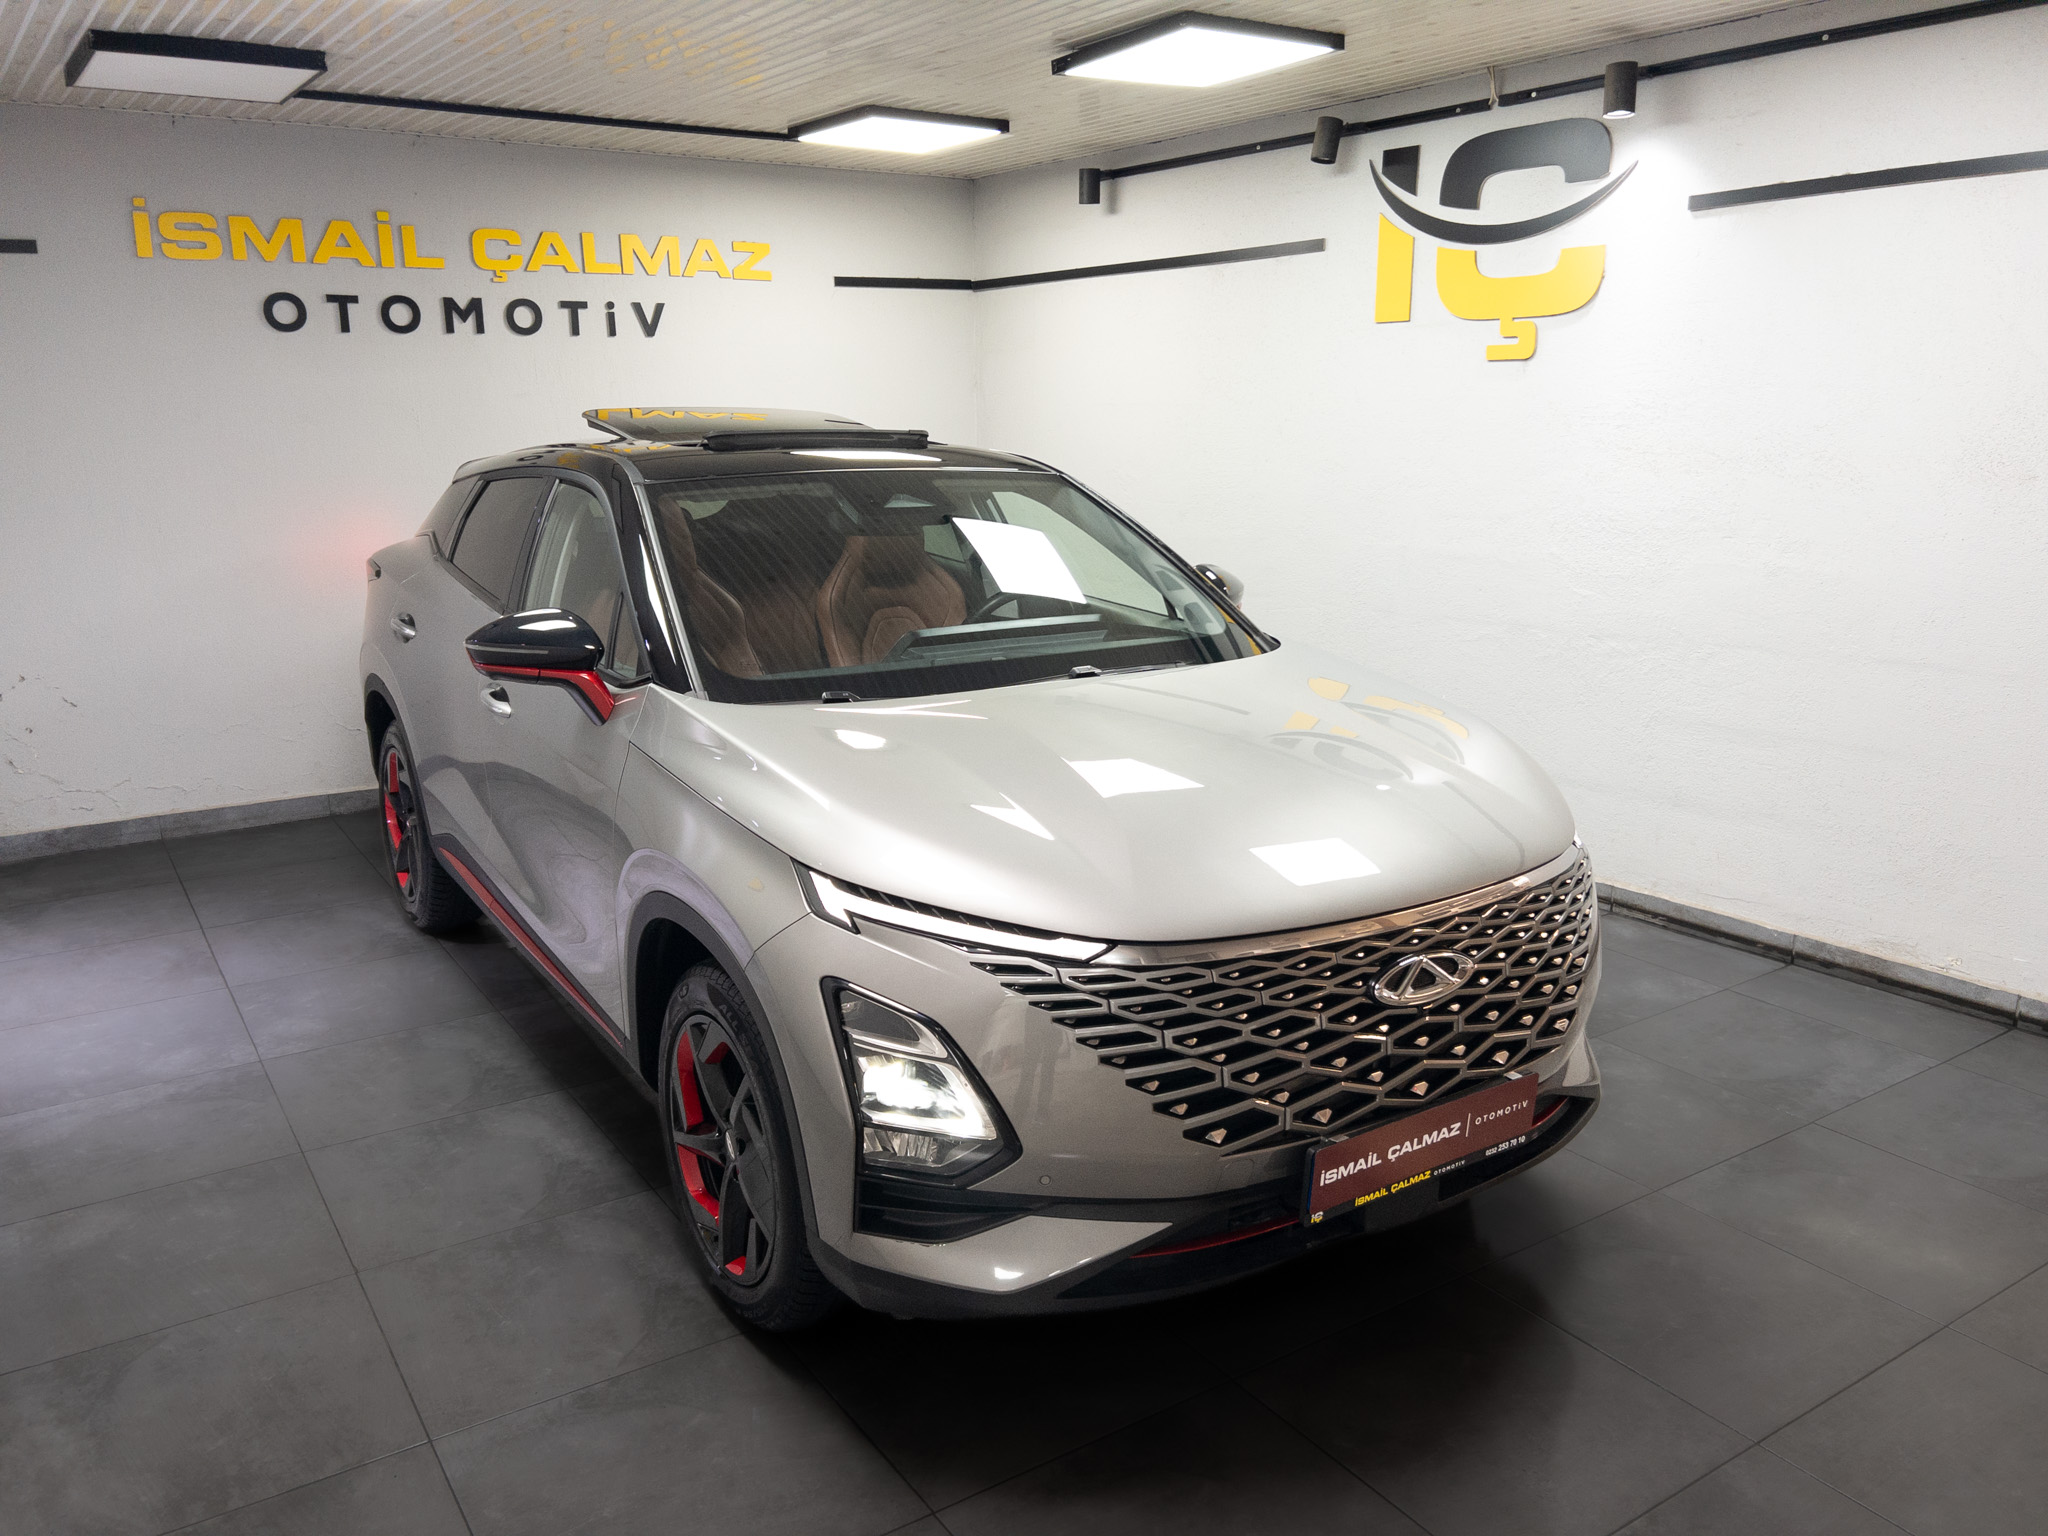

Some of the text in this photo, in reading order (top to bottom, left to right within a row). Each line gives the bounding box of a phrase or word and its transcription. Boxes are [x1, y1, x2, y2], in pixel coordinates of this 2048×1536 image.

[131, 197, 773, 283] İSMAİL ÇALMAZ
[1319, 1151, 1382, 1187] İSMAİL
[1387, 1121, 1462, 1163] ÇALMAZ
